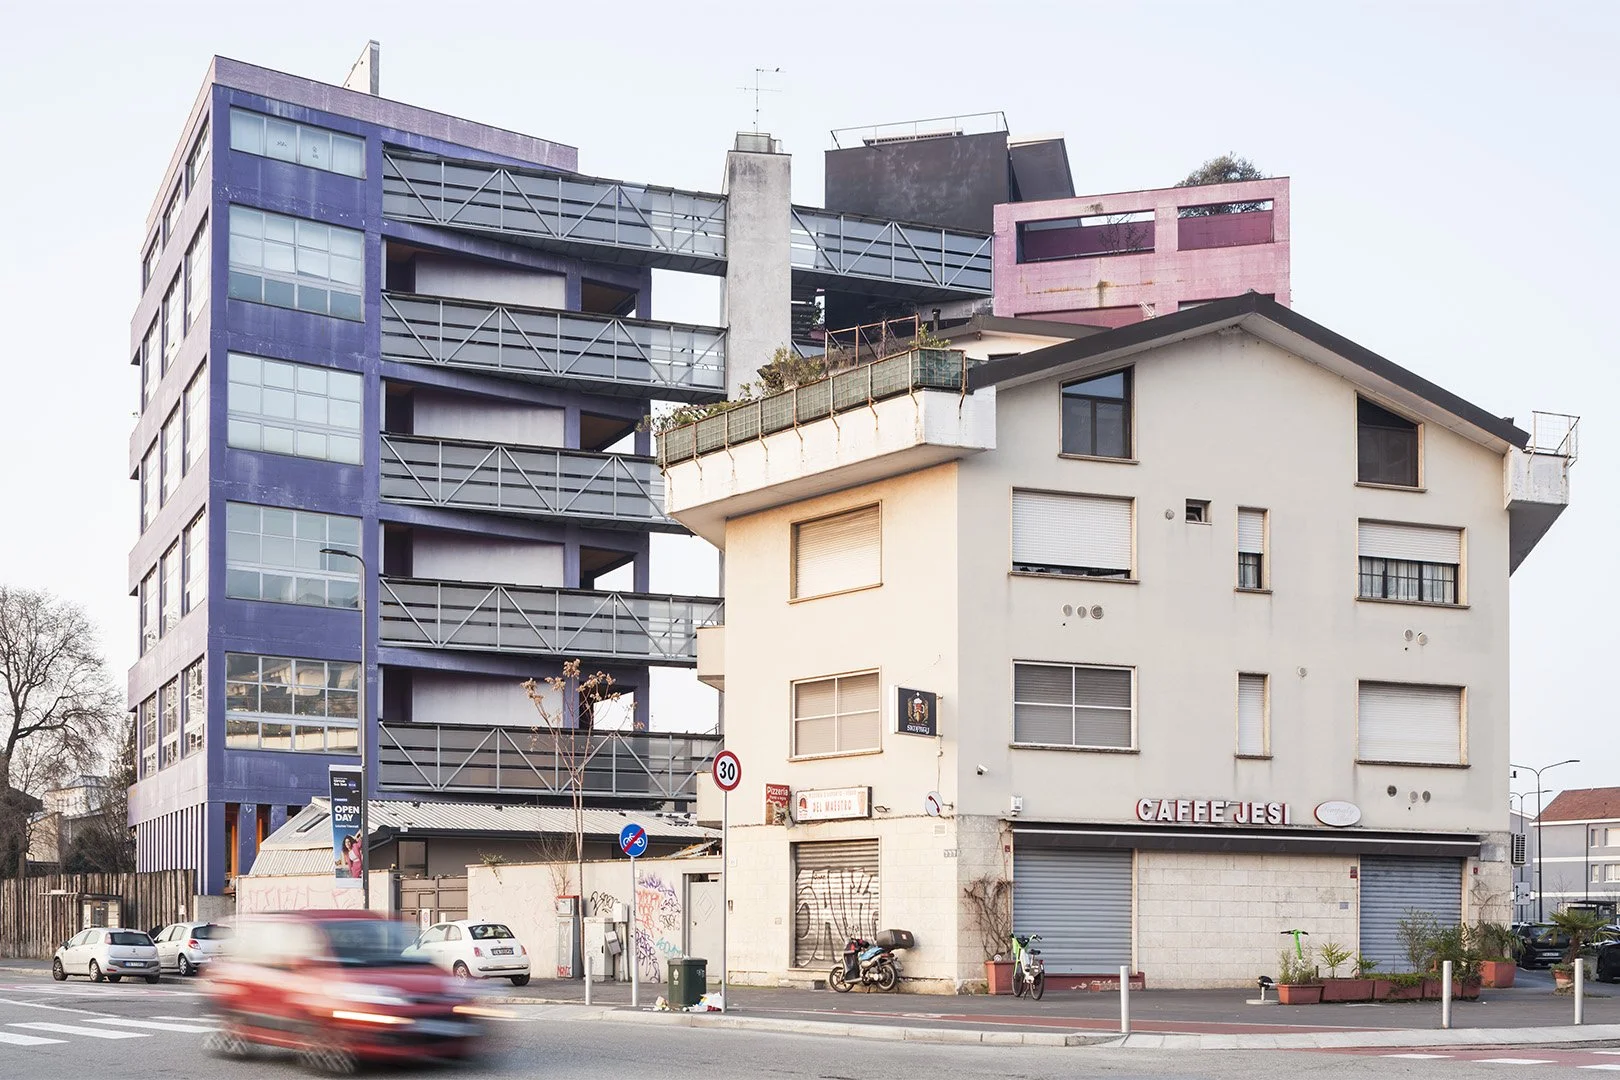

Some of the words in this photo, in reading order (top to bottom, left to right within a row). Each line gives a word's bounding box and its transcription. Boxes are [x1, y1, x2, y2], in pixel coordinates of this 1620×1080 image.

[720, 761, 735, 780] 30
[767, 785, 788, 796] Pizzeria
[334, 805, 360, 814] OPEN
[813, 802, 822, 812] DEL
[825, 799, 852, 812] MAESTRO
[335, 813, 354, 822] DAY
[1234, 801, 1291, 825] JESI
